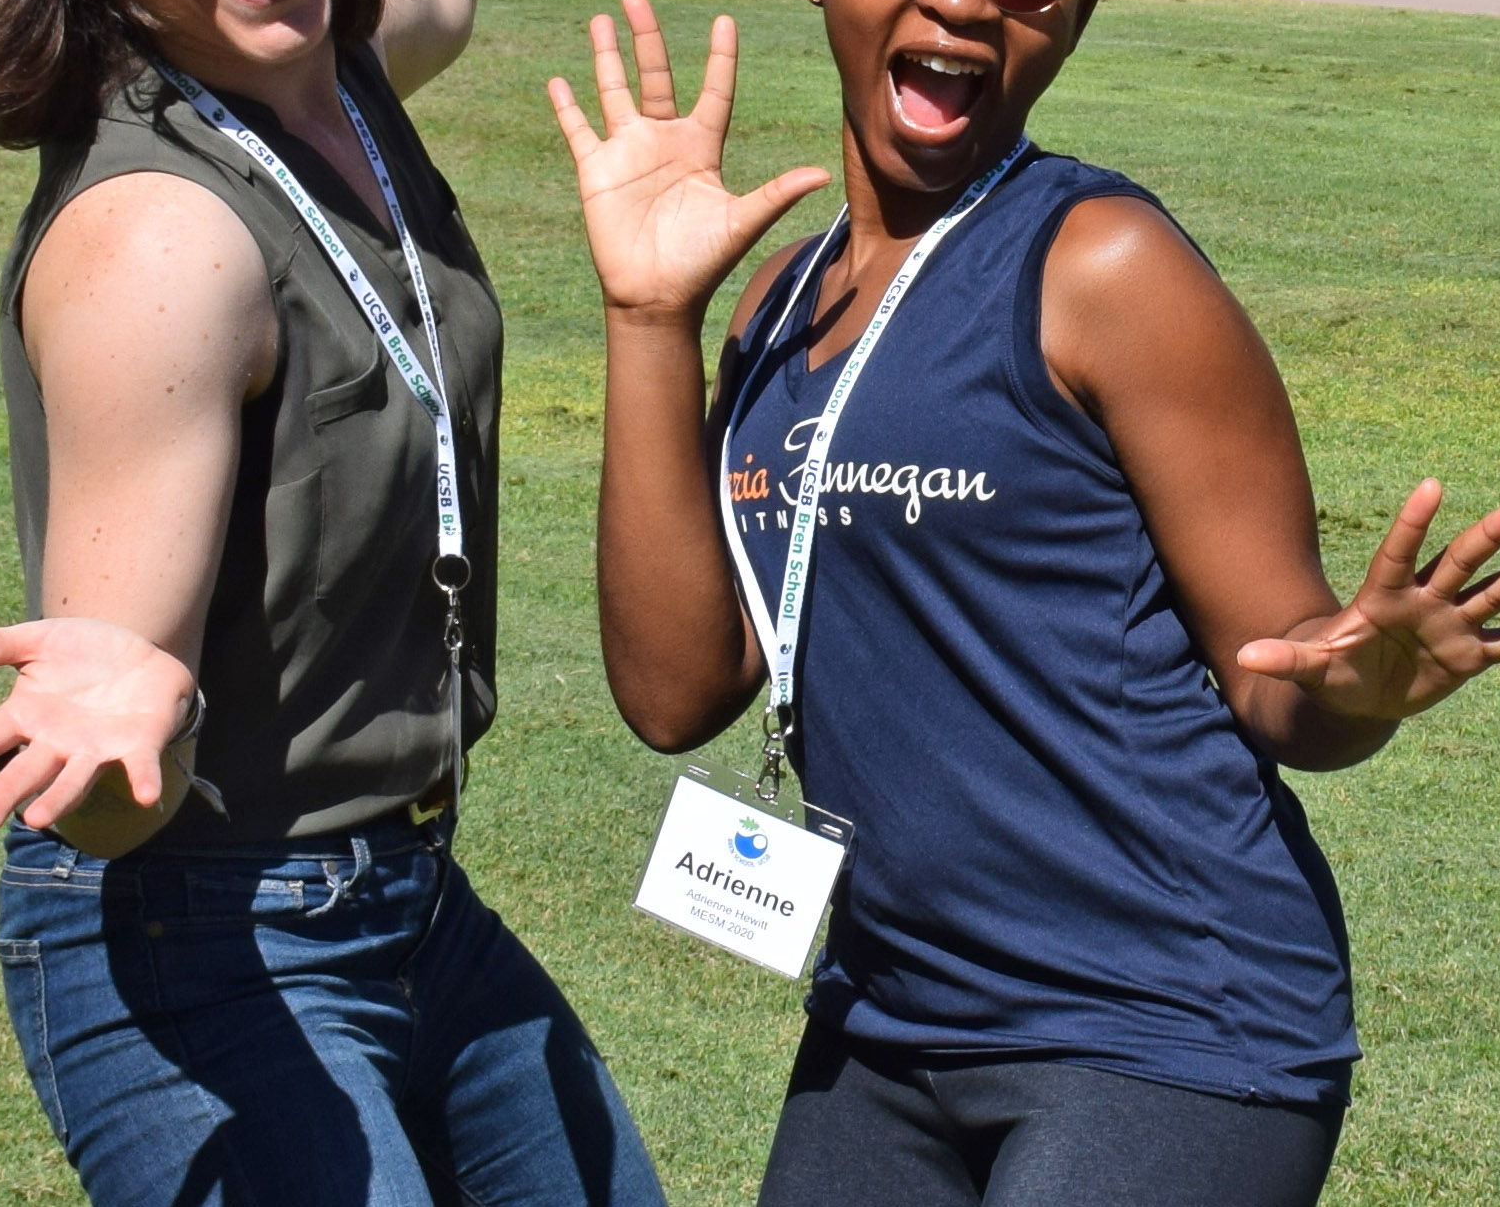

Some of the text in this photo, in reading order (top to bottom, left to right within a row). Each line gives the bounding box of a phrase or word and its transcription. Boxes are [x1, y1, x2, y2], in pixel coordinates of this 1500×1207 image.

[236, 128, 344, 259] UCSB Bren School
[363, 292, 445, 418] UCSB Bren School
[827, 274, 910, 414] UCSB Bren School
[438, 463, 452, 508] UCSB
[729, 455, 770, 501] ria
[741, 506, 852, 533] ITNSS
[782, 458, 820, 620] UCSB Bren School
[674, 851, 795, 917] Adrienne
[686, 888, 733, 916] Adrienne
[689, 905, 755, 941] MESM 2020
